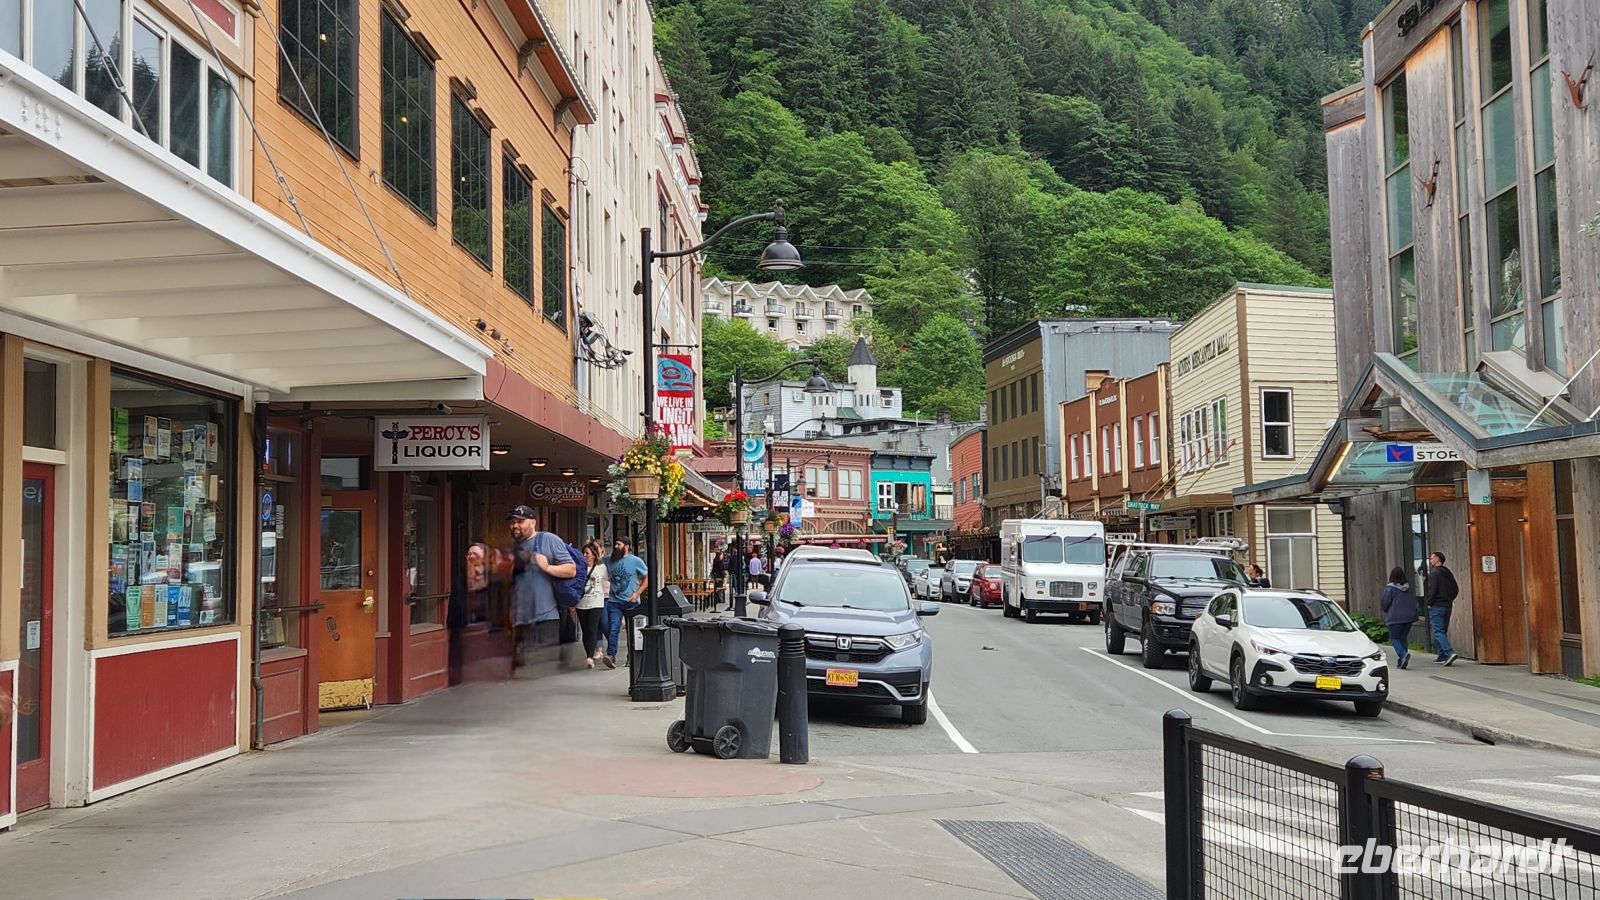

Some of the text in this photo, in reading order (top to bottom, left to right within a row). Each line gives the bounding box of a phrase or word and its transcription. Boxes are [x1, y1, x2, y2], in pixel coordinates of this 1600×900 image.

[657, 396, 668, 407] WE
[669, 397, 684, 407] LIVE
[408, 424, 480, 441] PERCY'S
[404, 445, 481, 457] LIQUOR
[744, 463, 765, 471] WE ARE
[743, 471, 766, 481] WATER
[531, 482, 581, 497] CRYSTAL
[743, 480, 766, 490] PEOPLE
